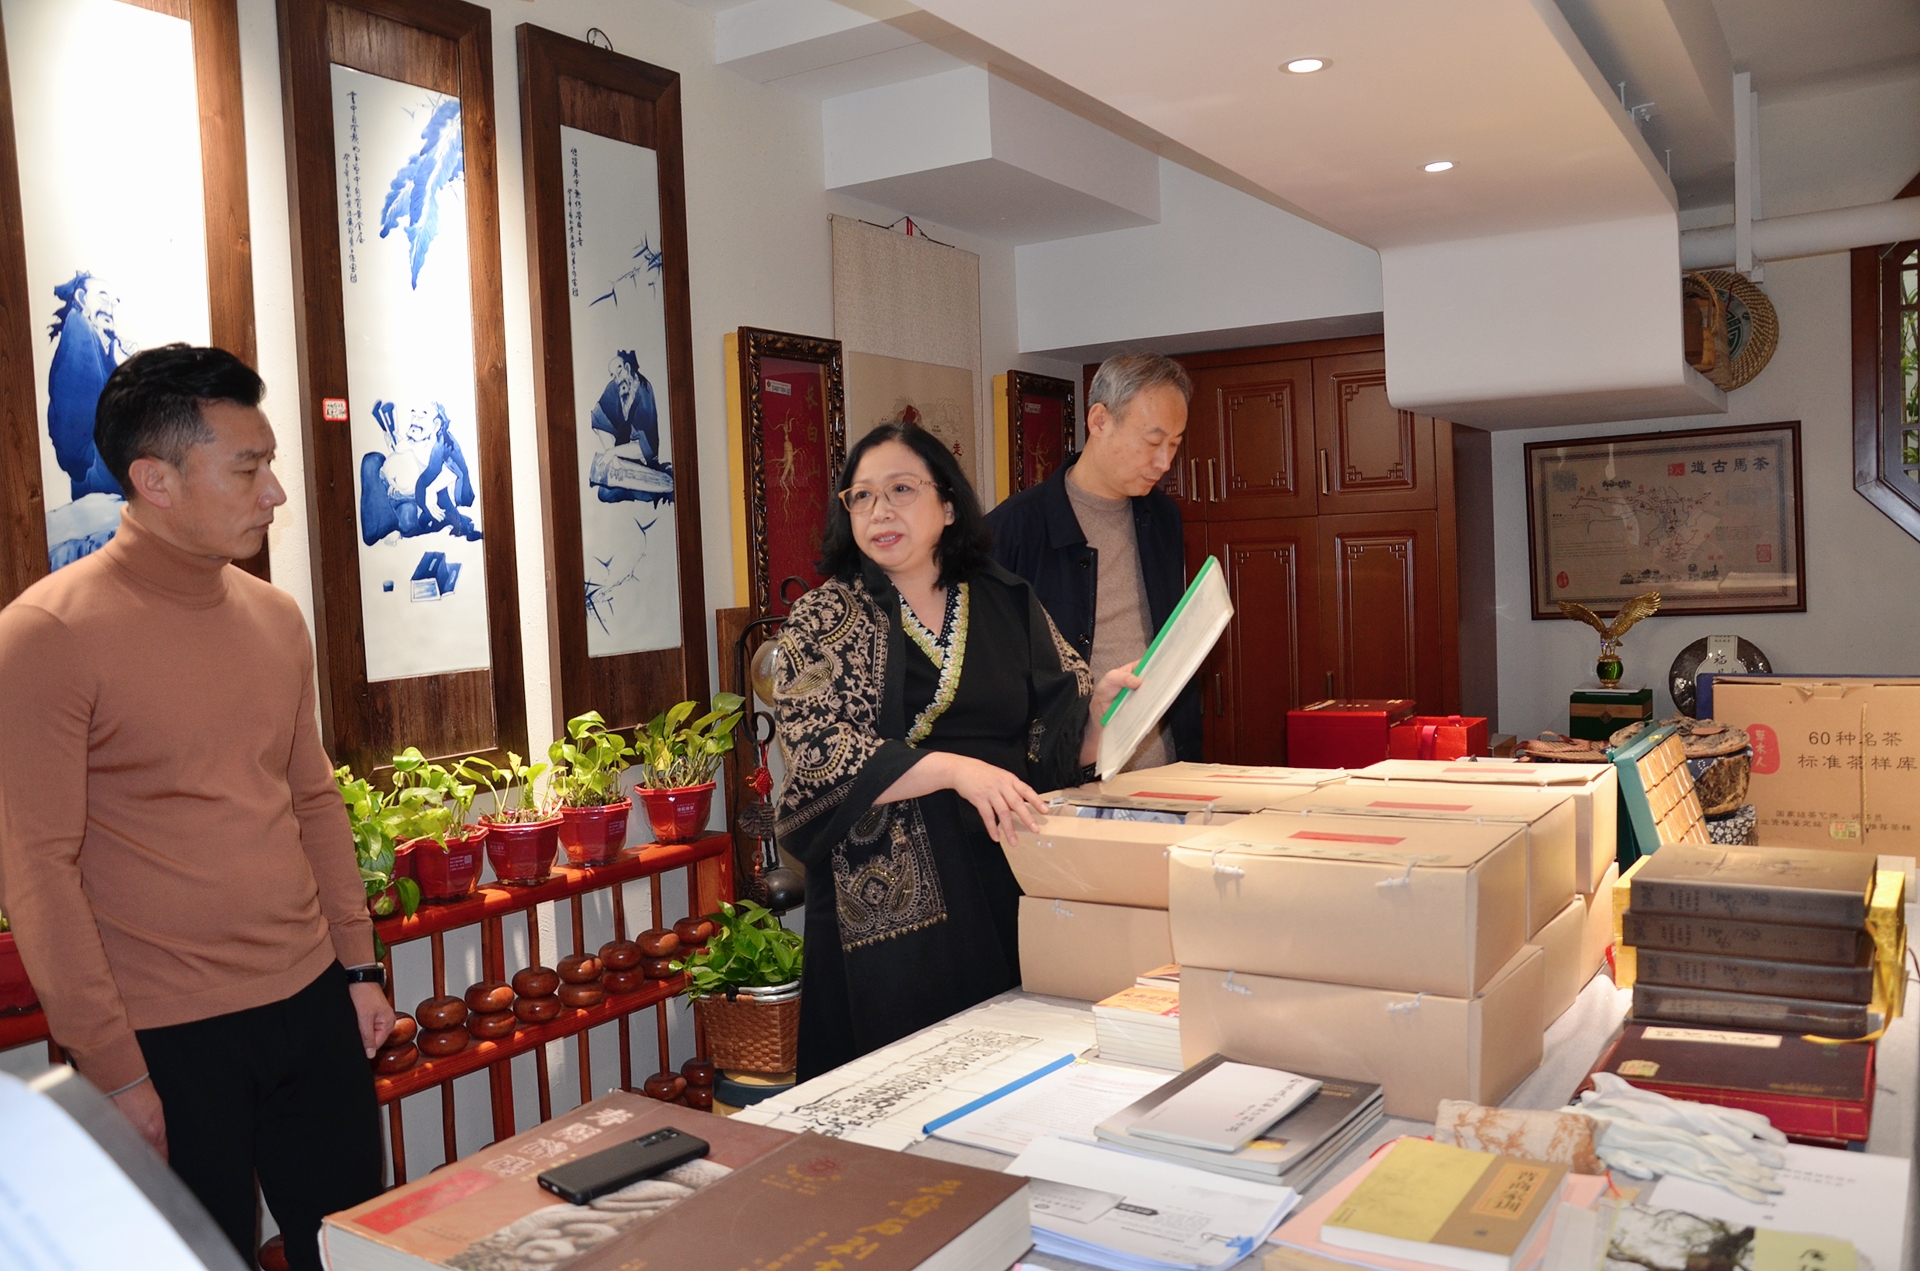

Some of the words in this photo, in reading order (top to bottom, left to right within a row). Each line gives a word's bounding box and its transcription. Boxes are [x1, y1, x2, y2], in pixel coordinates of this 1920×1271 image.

[1798, 754, 1918, 771] 标准茶样库
